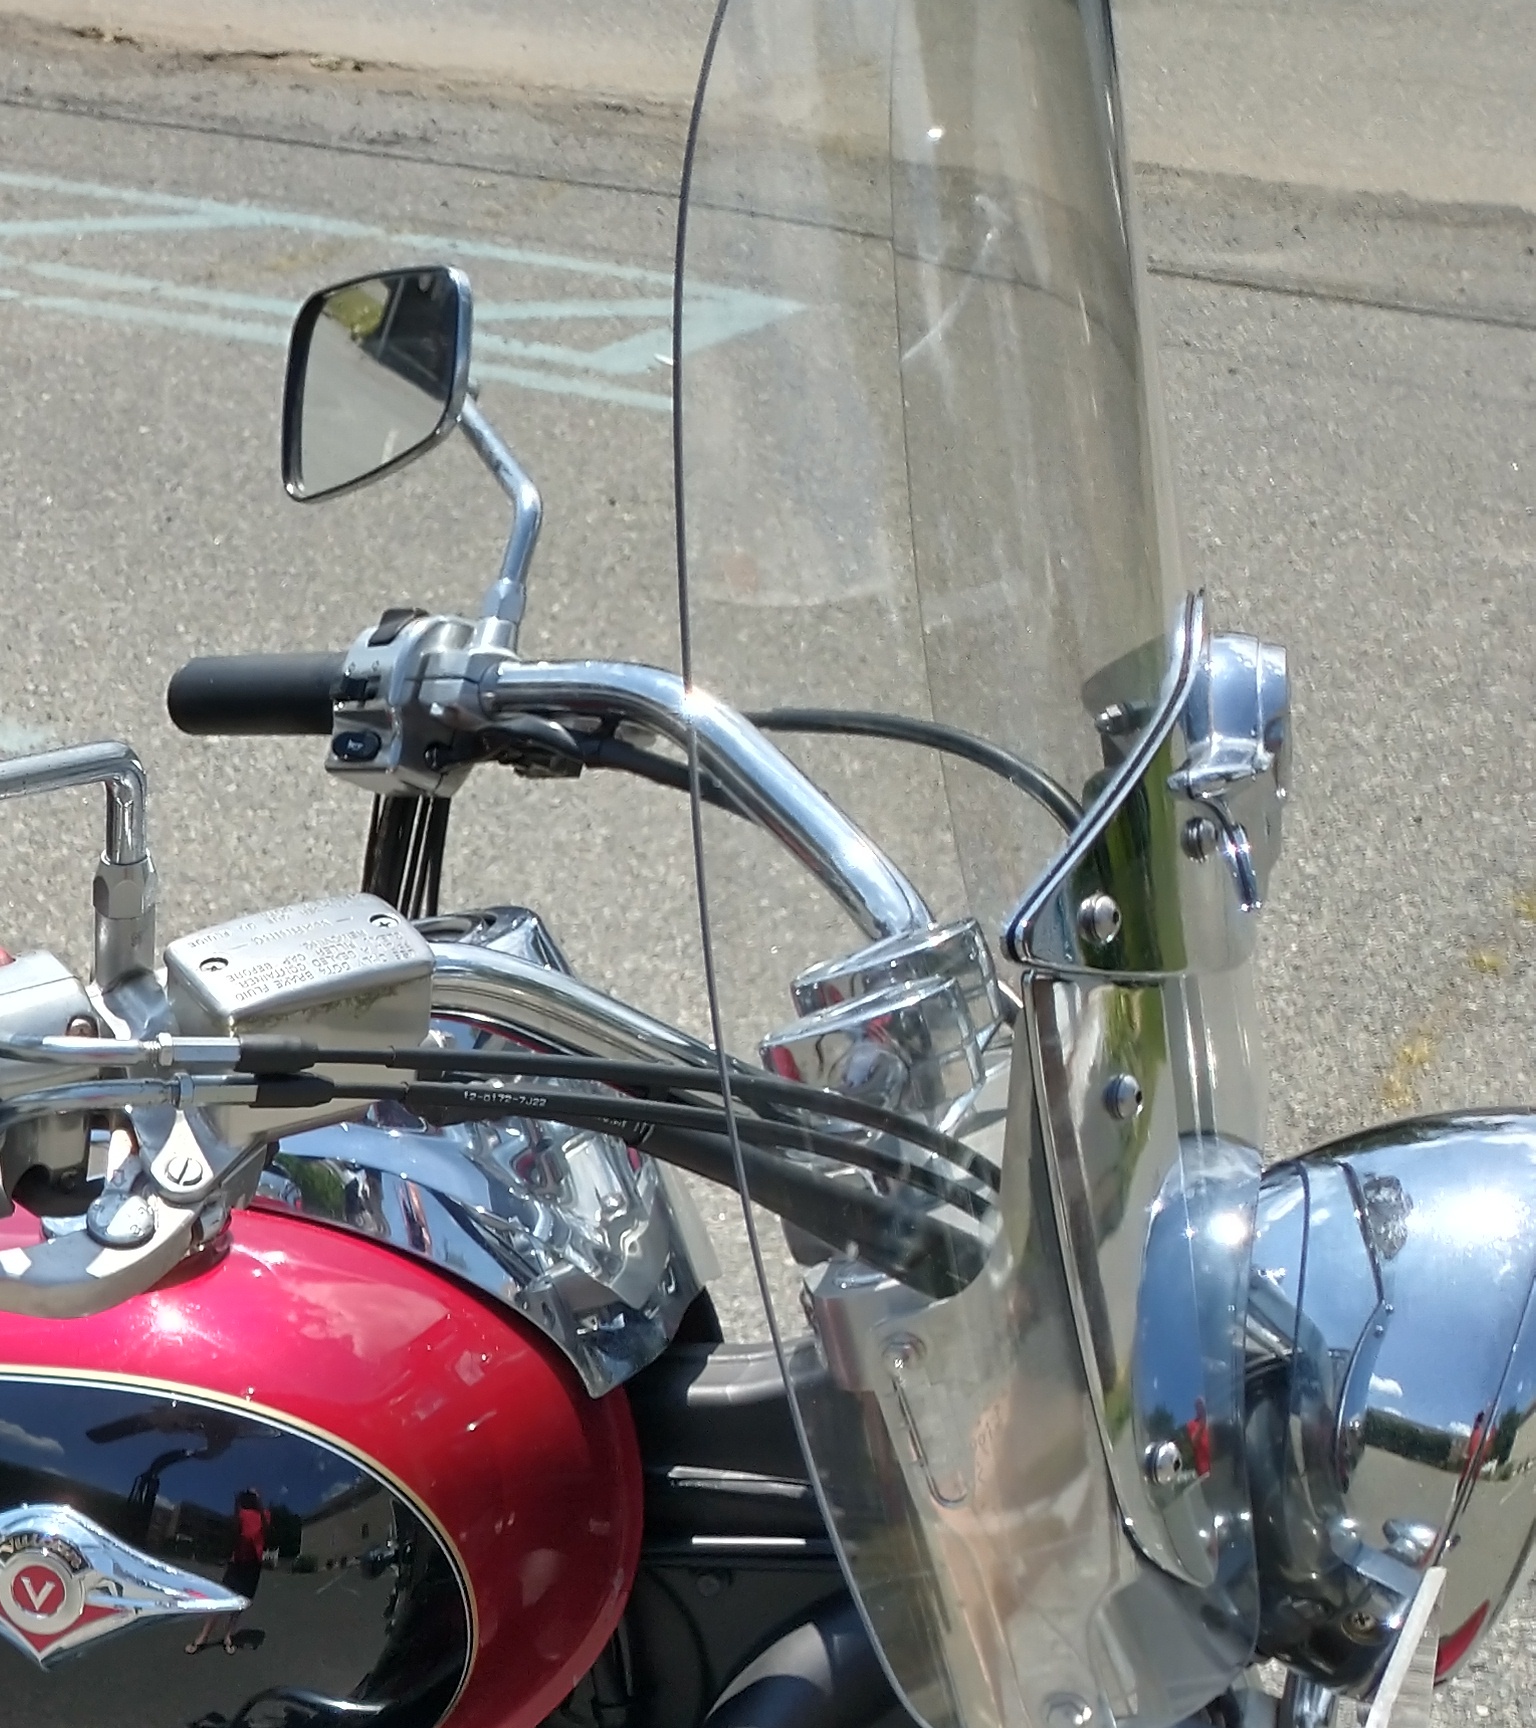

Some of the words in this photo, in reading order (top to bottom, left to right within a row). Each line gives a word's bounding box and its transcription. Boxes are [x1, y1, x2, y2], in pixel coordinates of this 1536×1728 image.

[225, 961, 274, 983] BEFORE
[238, 962, 307, 989] CONTAINER
[234, 983, 270, 1002] FLUID
[20, 1575, 56, 1612] V
